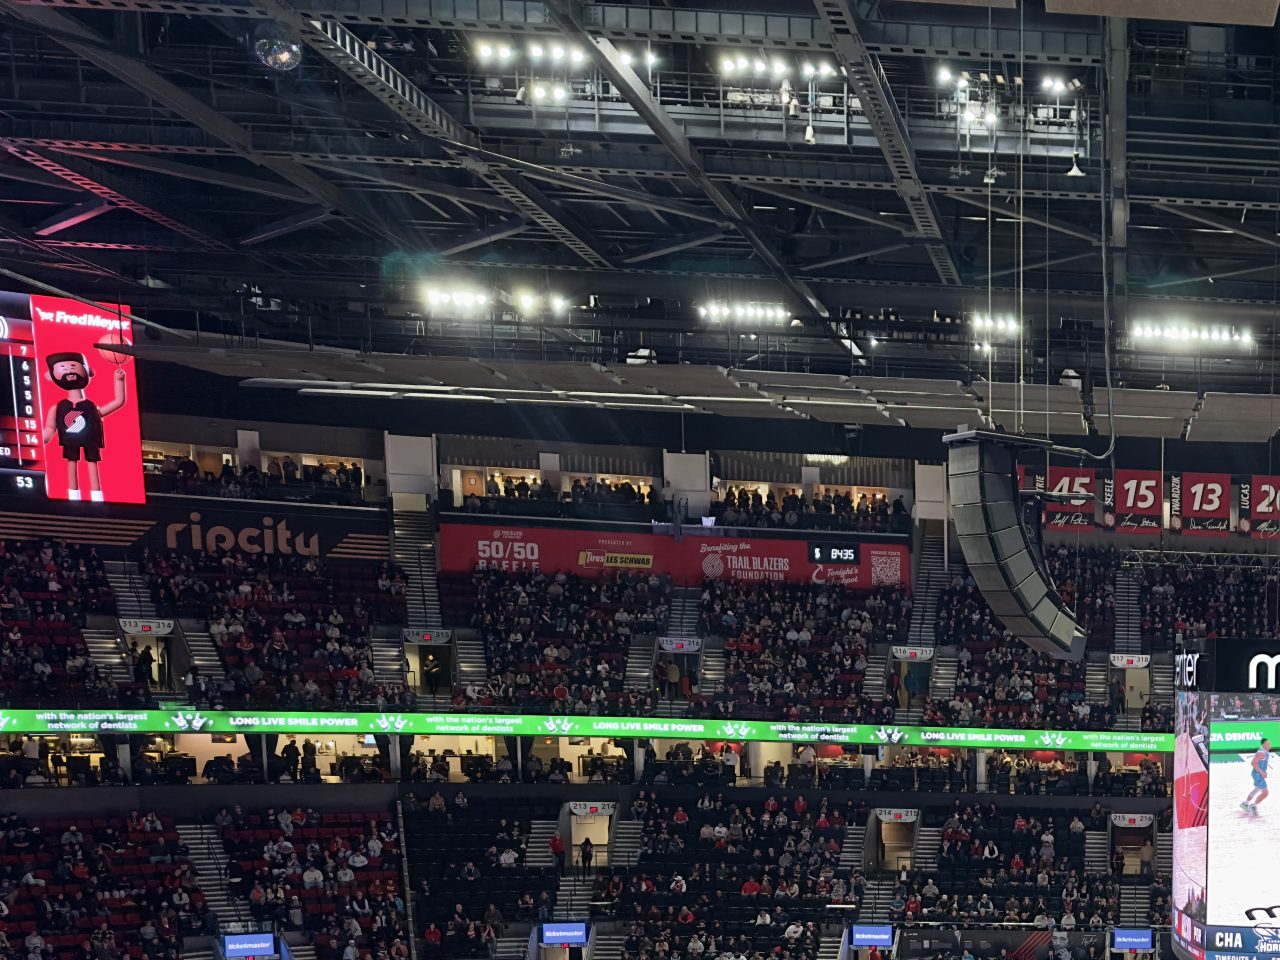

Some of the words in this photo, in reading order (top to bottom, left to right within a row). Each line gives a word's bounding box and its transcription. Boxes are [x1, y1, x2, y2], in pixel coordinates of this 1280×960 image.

[20, 346, 27, 355] 7
[21, 361, 29, 371] 6
[23, 376, 31, 385] 5
[25, 391, 32, 400] 5
[25, 406, 33, 415] 0
[24, 420, 36, 429] 15
[25, 434, 38, 444] 14
[30, 450, 36, 458] 1
[16, 477, 33, 488] 53
[1052, 476, 1091, 506] 45
[1103, 478, 1114, 507] STEELE
[1123, 480, 1156, 508] 15
[1171, 475, 1181, 515] TWARDZIK
[1190, 483, 1223, 511] 13
[1240, 484, 1250, 509] LUCAS
[478, 540, 539, 560] 50/50
[700, 543, 739, 553] Benefiting
[740, 542, 751, 550] the
[831, 548, 854, 560] 8435
[606, 555, 618, 564] LES
[620, 556, 650, 565] SCHWAB
[727, 556, 751, 570] TRAIL
[752, 557, 789, 571] BLAZERS
[731, 571, 784, 581] FOUNDATION
[827, 567, 859, 578] Tonight's
[36, 712, 57, 720] with
[58, 712, 75, 720] the
[77, 712, 113, 720] nation's
[115, 712, 148, 722] largest
[229, 717, 261, 726] LONG
[261, 717, 286, 726] LIVE
[287, 717, 319, 726] SMILE
[319, 717, 358, 727] POWER
[88, 721, 99, 729] of
[100, 721, 138, 729] dentists
[921, 732, 946, 740] LONG
[946, 733, 966, 741] LIVE
[967, 733, 993, 741] SMILE
[993, 734, 1026, 742] POWER
[546, 930, 584, 938] ticketmaster
[1215, 932, 1243, 948] CHA
[228, 942, 271, 950] ticketmaster
